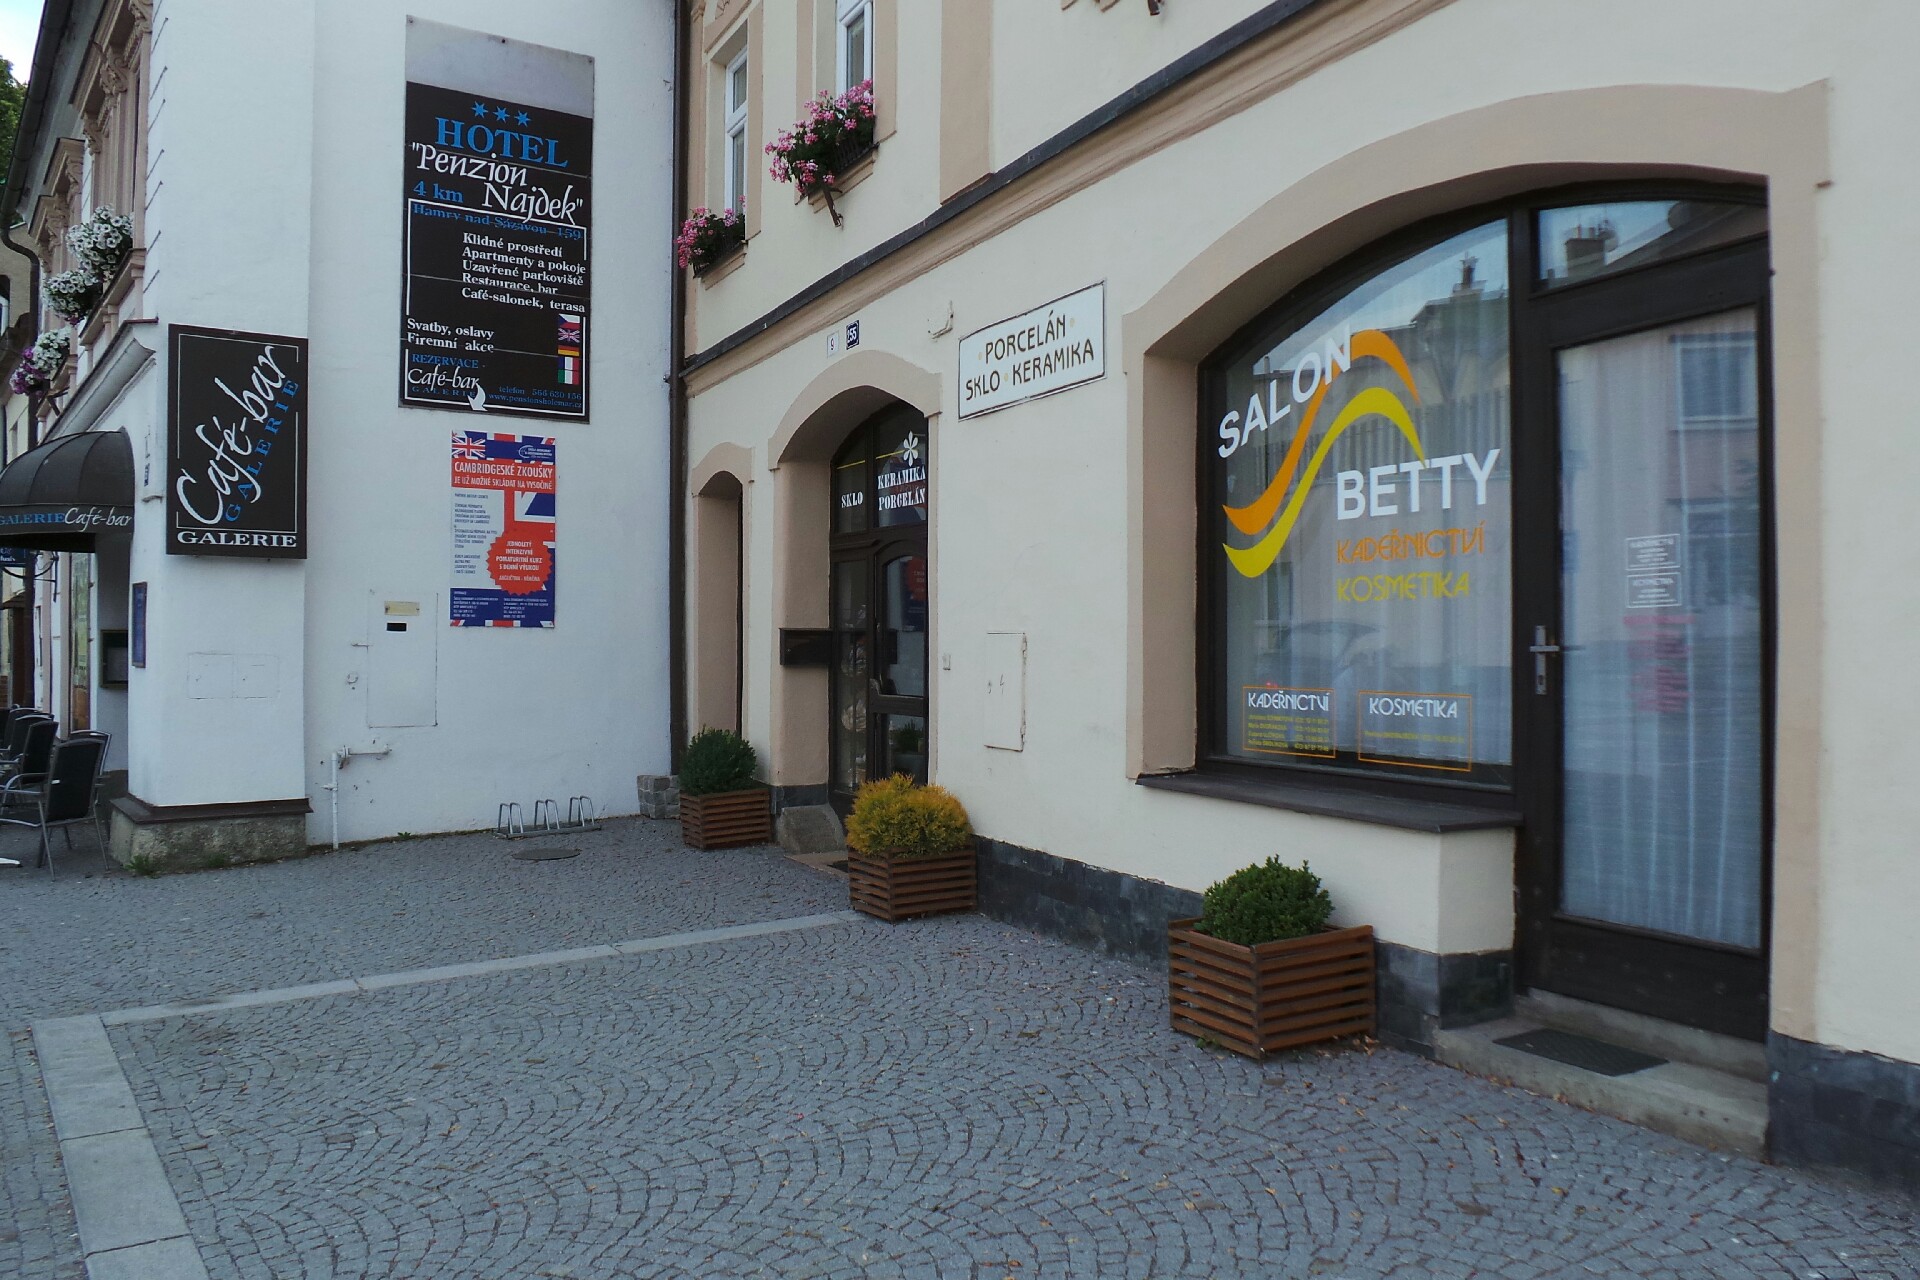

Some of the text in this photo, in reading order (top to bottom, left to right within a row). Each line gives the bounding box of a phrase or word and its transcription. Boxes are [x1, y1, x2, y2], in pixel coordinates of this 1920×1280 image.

[435, 116, 568, 167] HOTEL
[412, 141, 527, 186] "Penzion
[413, 180, 463, 202] 4 km
[482, 182, 583, 225] Najdek"
[413, 203, 582, 241] Hamry nad Sázavou 159
[463, 232, 563, 258] Klidné prostředí
[462, 246, 586, 275] Apartmenty a pokoje
[462, 259, 584, 286] Uzavřené parkoviště
[462, 272, 558, 295] Restaurace, bar
[461, 287, 586, 313] Café-salonek, terasa
[407, 318, 495, 341] Svatby, oslavy
[407, 331, 494, 353] Firemní akce
[985, 310, 1066, 365] PORCELÁN
[412, 353, 479, 369] REZERVACE
[965, 338, 1095, 401] SKLO KERAMIKA
[407, 364, 480, 391] Café-bar
[499, 386, 525, 395] telefon
[1218, 324, 1351, 459] SALON
[175, 345, 286, 525] Café-bar
[224, 379, 299, 522] GALERIE
[454, 461, 553, 479] CAMBRIDGESKÉ ZKOUŠKY
[877, 465, 926, 490] KERAMIKA
[1337, 448, 1501, 521] BETTY
[841, 491, 864, 508] SKLO
[878, 486, 926, 511] PORCELÁN
[64, 506, 133, 532] Café-bar
[176, 530, 298, 548] GALERIE
[1336, 521, 1486, 564] KADEŘNICTVÍ
[1336, 571, 1470, 602] KOSMETIKA
[1247, 690, 1329, 712] KADEŘNICTVÍ
[1369, 697, 1458, 719] KOSMETIKA
